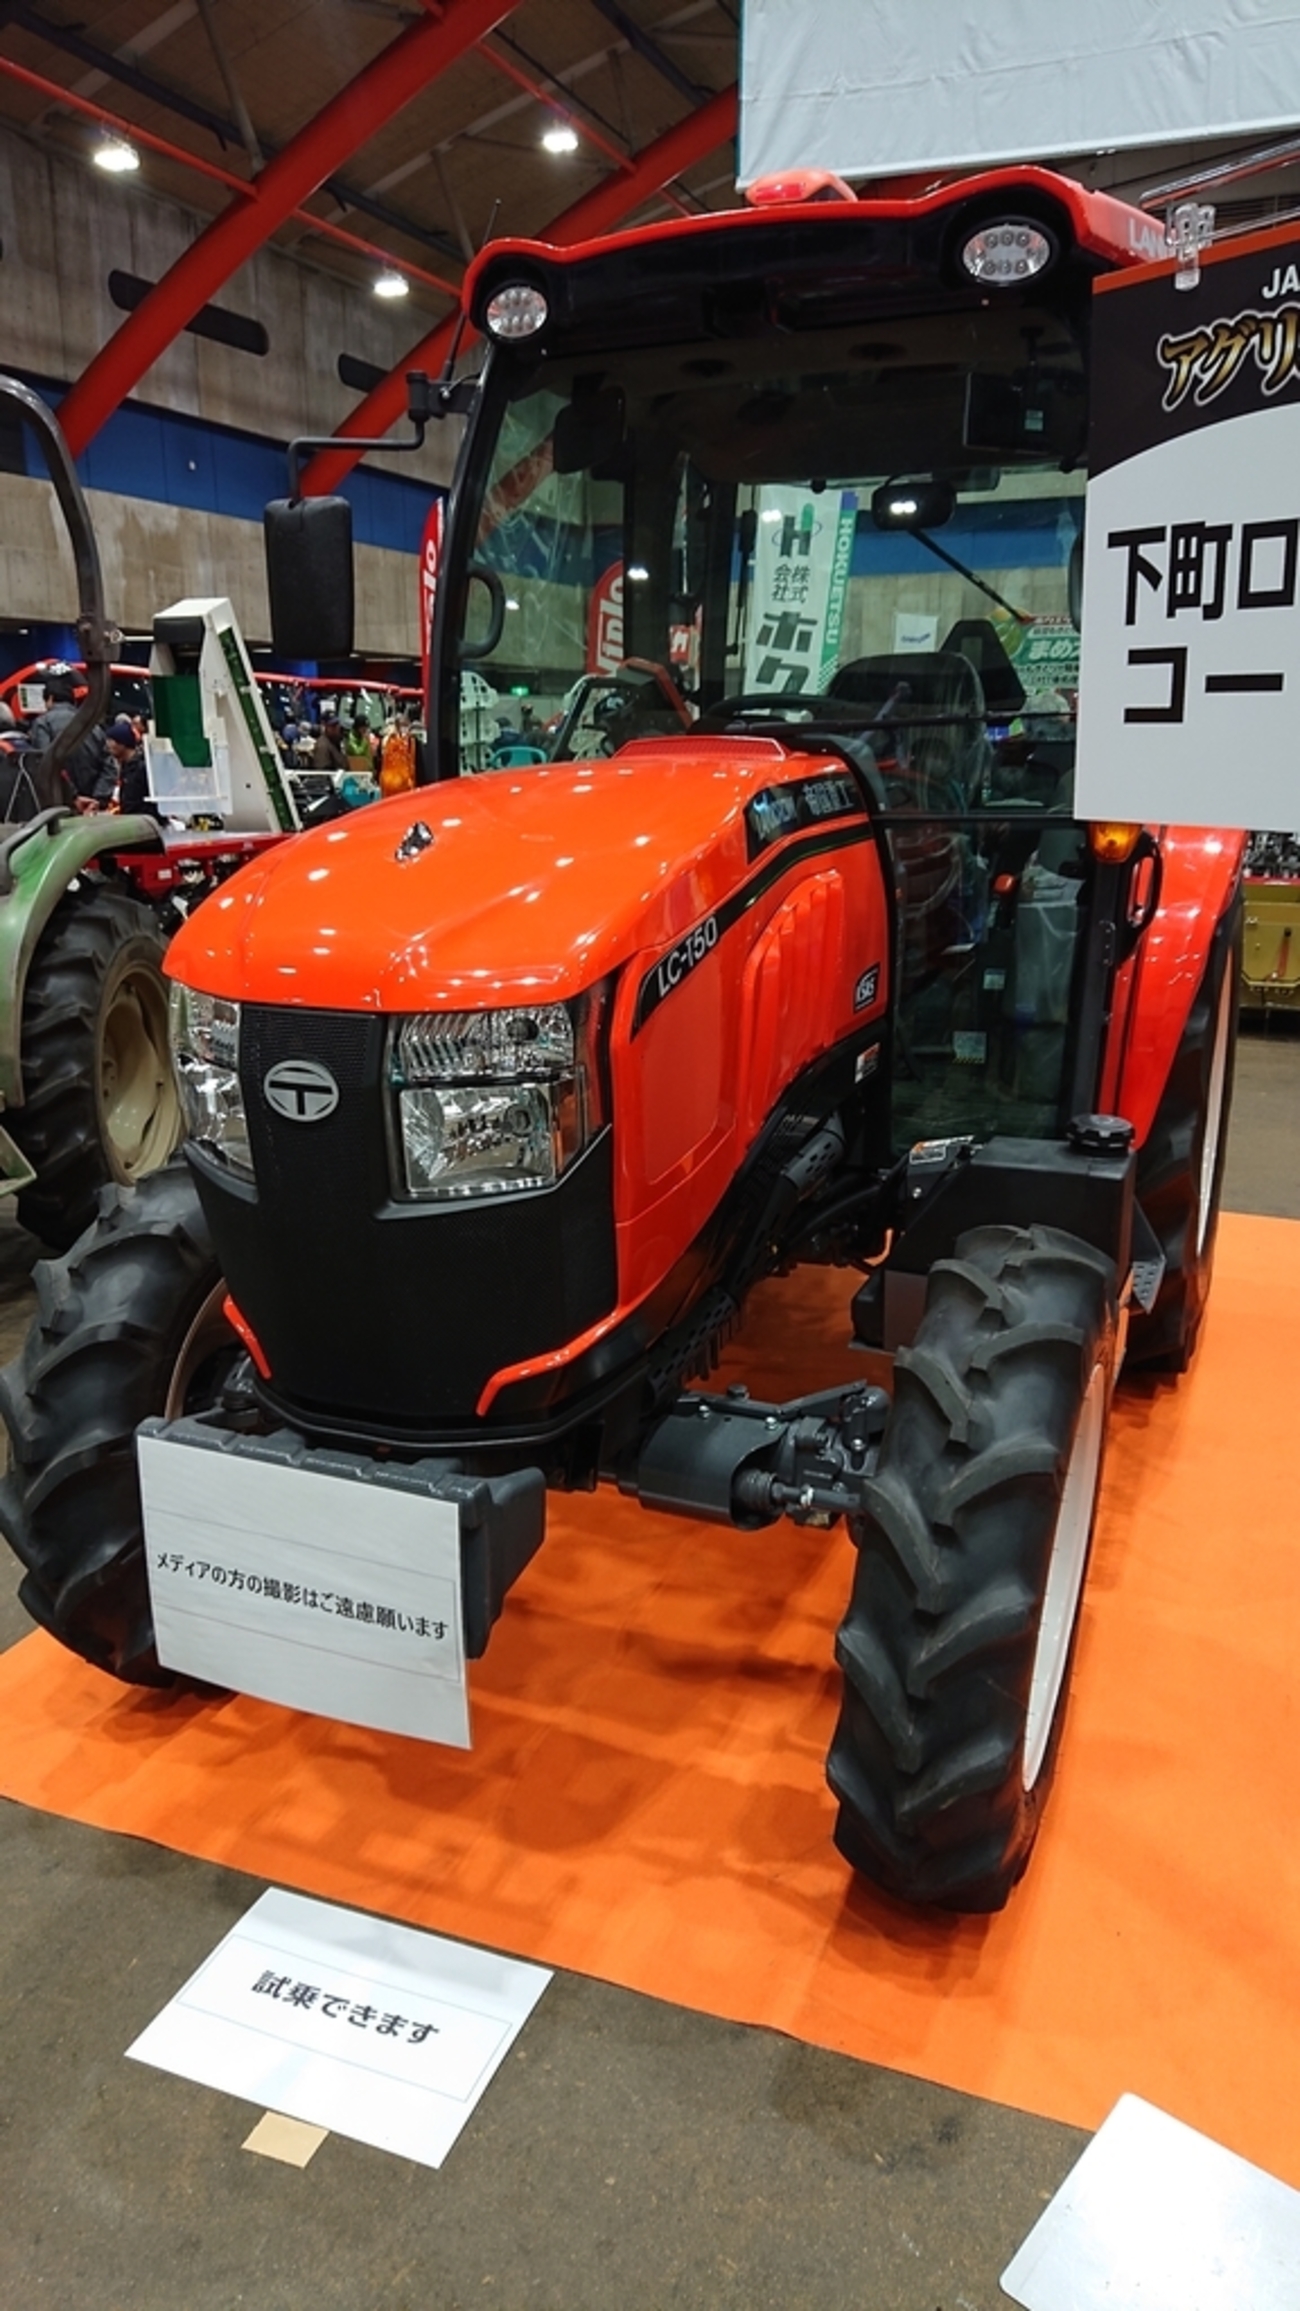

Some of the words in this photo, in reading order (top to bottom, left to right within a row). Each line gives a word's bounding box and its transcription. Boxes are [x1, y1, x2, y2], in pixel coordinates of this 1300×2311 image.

[1262, 264, 1300, 299] JA
[826, 517, 853, 645] HOKUETSU
[1107, 518, 1300, 626] 下町ロ
[1124, 646, 1284, 724] コー
[657, 916, 718, 998] LC-T50
[156, 1552, 449, 1640] メディアの方の撮影はご遠慮願います
[251, 1970, 440, 2044] 試乗できます
